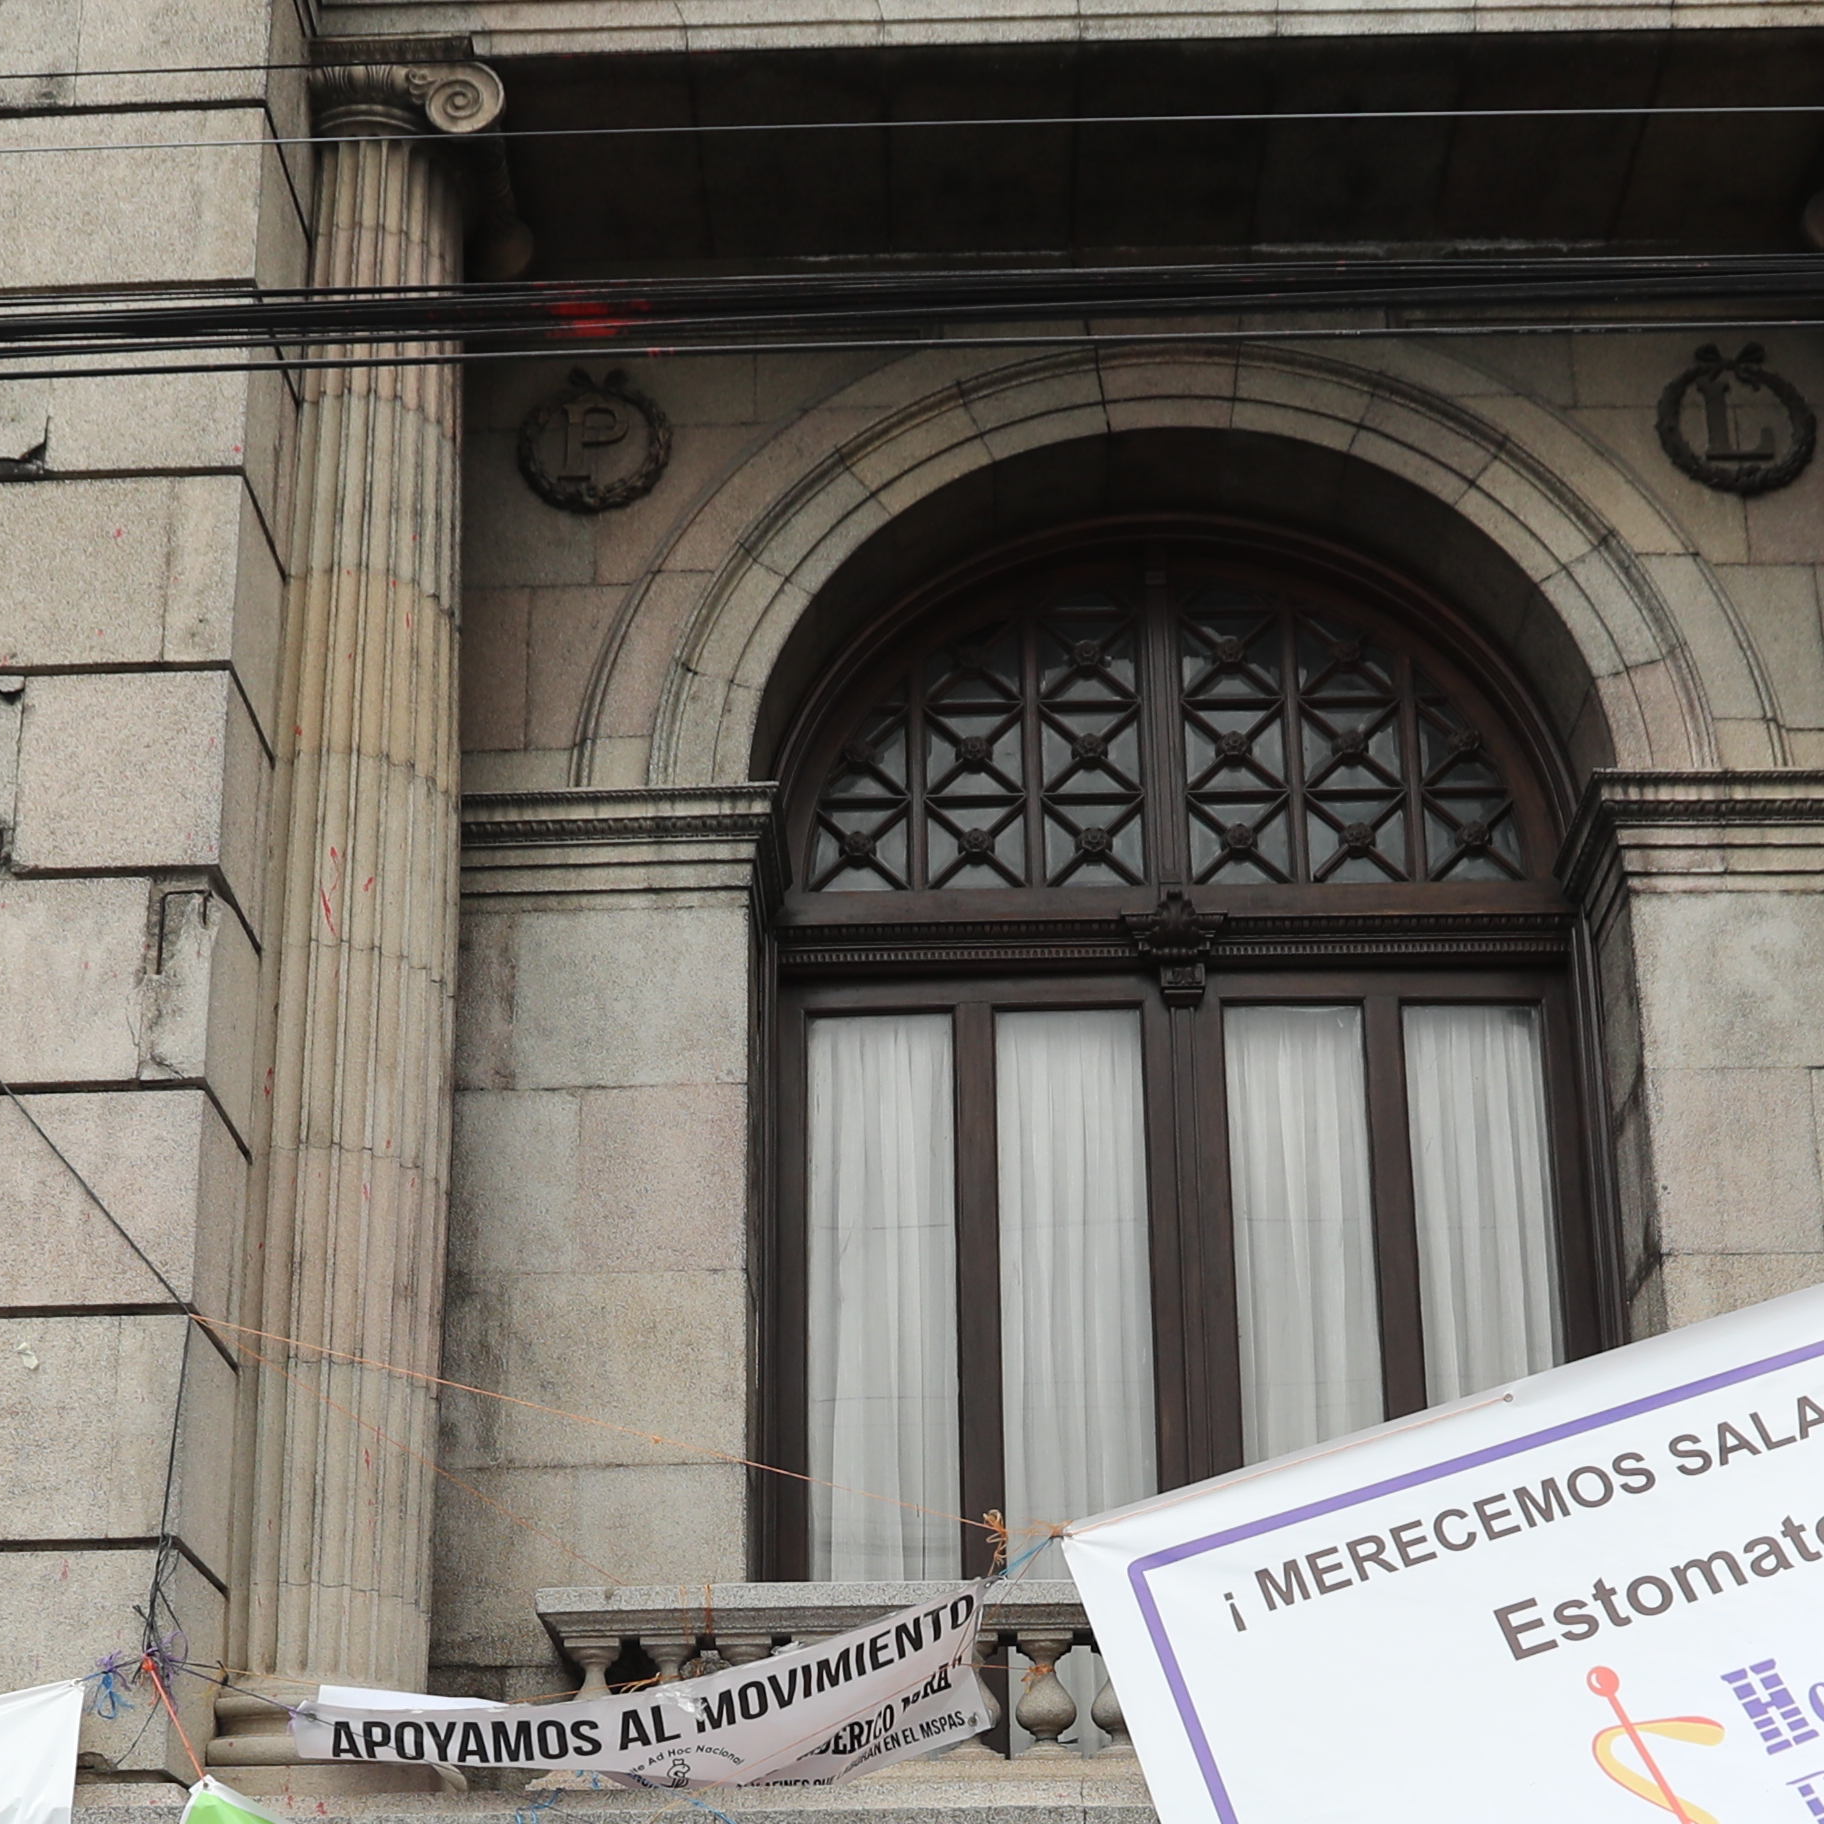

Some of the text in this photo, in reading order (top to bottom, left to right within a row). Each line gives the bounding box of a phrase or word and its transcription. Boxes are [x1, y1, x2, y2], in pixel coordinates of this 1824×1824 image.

[1696, 375, 1776, 460] L
[1252, 1452, 1657, 1613] MERECEMOS
[331, 1718, 604, 1765] APOYAMOS
[617, 1705, 686, 1752] AL
[697, 1593, 977, 1735] MOVIMIENTO
[667, 1744, 745, 1766] Hoc Nacional
[884, 1710, 966, 1751] EN EL MSPAS
